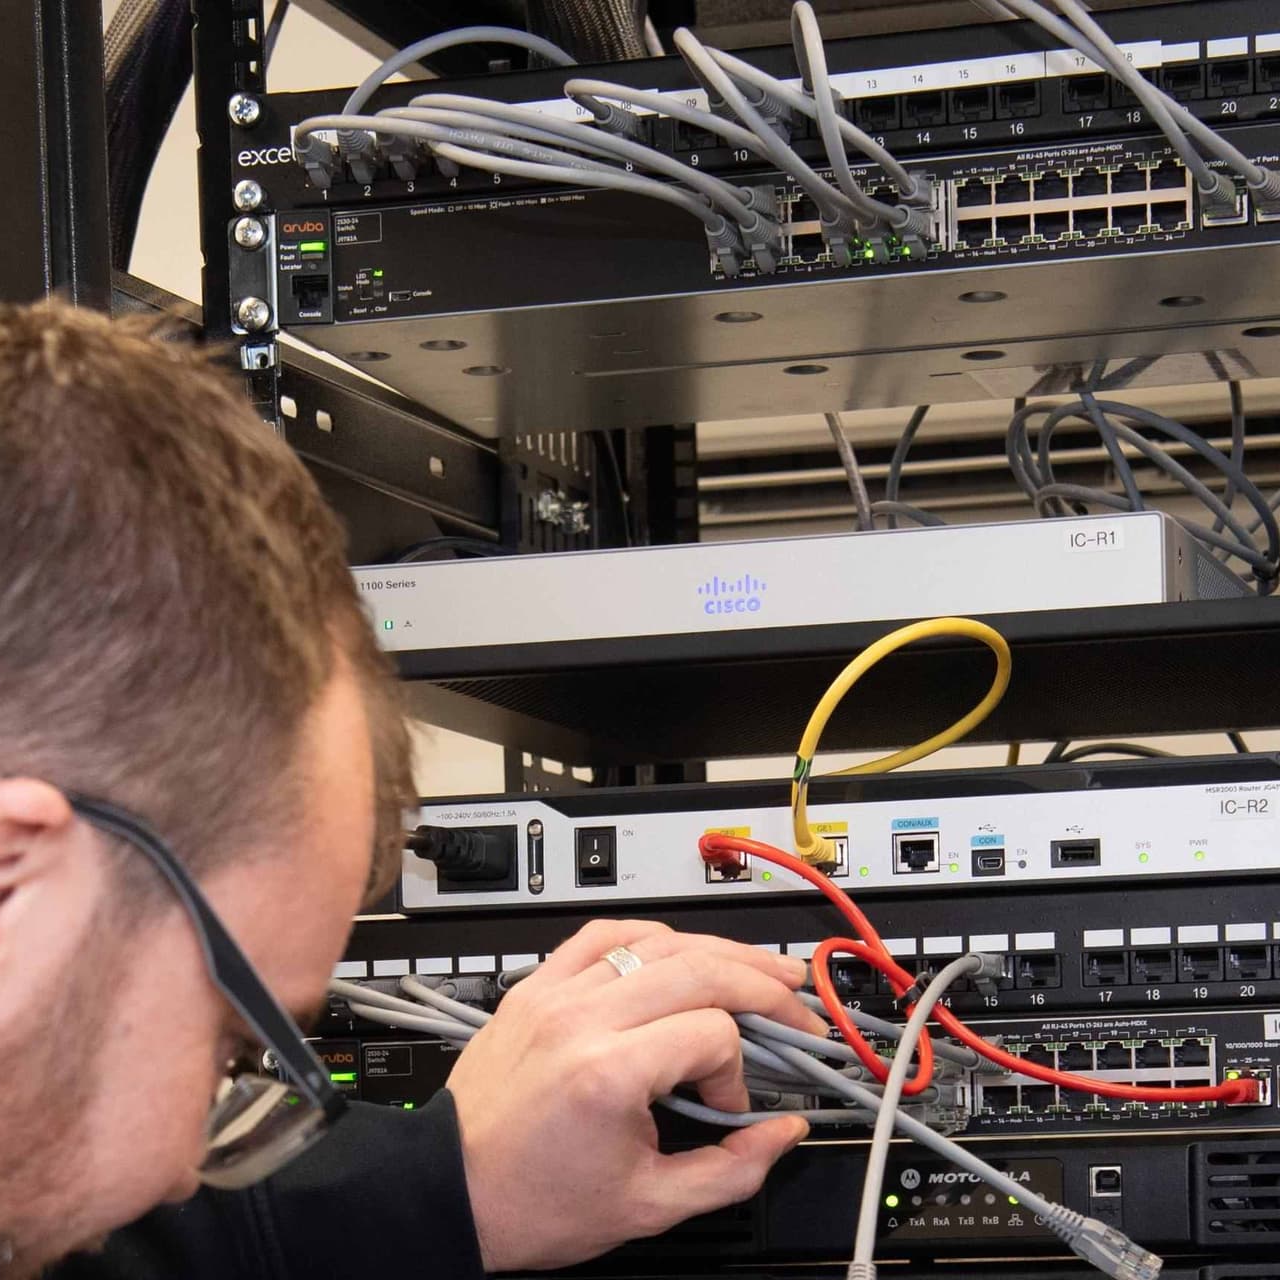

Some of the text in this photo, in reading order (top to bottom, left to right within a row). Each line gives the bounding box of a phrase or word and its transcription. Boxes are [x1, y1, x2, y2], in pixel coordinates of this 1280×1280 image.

[1075, 57, 1087, 66] 17
[959, 69, 969, 79] 15
[1006, 64, 1017, 74] 16
[867, 79, 877, 89] 13
[913, 75, 924, 84] 14
[686, 98, 697, 108] 09
[1221, 102, 1237, 114] 20
[1078, 116, 1093, 128] 17
[1126, 111, 1141, 123] 18
[962, 127, 978, 140] 15
[1009, 122, 1025, 135] 16
[916, 132, 931, 145] 14
[237, 146, 297, 167] excel
[733, 150, 748, 162] 10
[1044, 150, 1060, 159] Ports
[690, 154, 699, 166] 9
[450, 177, 458, 188] 4
[493, 174, 501, 185] 5
[363, 186, 371, 197] 2
[407, 181, 415, 193] 3
[322, 189, 328, 200] 1
[282, 221, 325, 235] aruba
[279, 243, 298, 252] Power
[279, 254, 296, 262] Fault
[280, 263, 303, 272] Locator
[413, 290, 433, 298] Console
[298, 310, 322, 320] Console
[1070, 531, 1115, 548] IC-R1
[360, 579, 417, 591] 1100 Series
[704, 597, 761, 615] CISCO
[1205, 786, 1238, 794] MSR2003
[1220, 798, 1269, 815] IC-R2
[897, 820, 933, 829] CON/AUX
[622, 829, 635, 838] ON
[978, 836, 998, 845] CON
[1135, 841, 1151, 849] SYS
[1189, 838, 1208, 848] PWR
[948, 851, 960, 859] EN
[1016, 848, 1028, 856] EN
[621, 873, 638, 882] OFF
[1145, 989, 1160, 1001] 18
[1193, 987, 1208, 999] 19
[1239, 985, 1256, 997] 20
[984, 996, 998, 1008] 15
[1029, 994, 1045, 1006] 16
[1099, 991, 1113, 1003] 17
[1068, 1022, 1085, 1030] Ports
[1225, 1041, 1263, 1050] 10/100/1000
[910, 1217, 925, 1226] TxA
[933, 1217, 950, 1226] RxA
[958, 1216, 974, 1225] TxB
[982, 1215, 999, 1225] RxB
